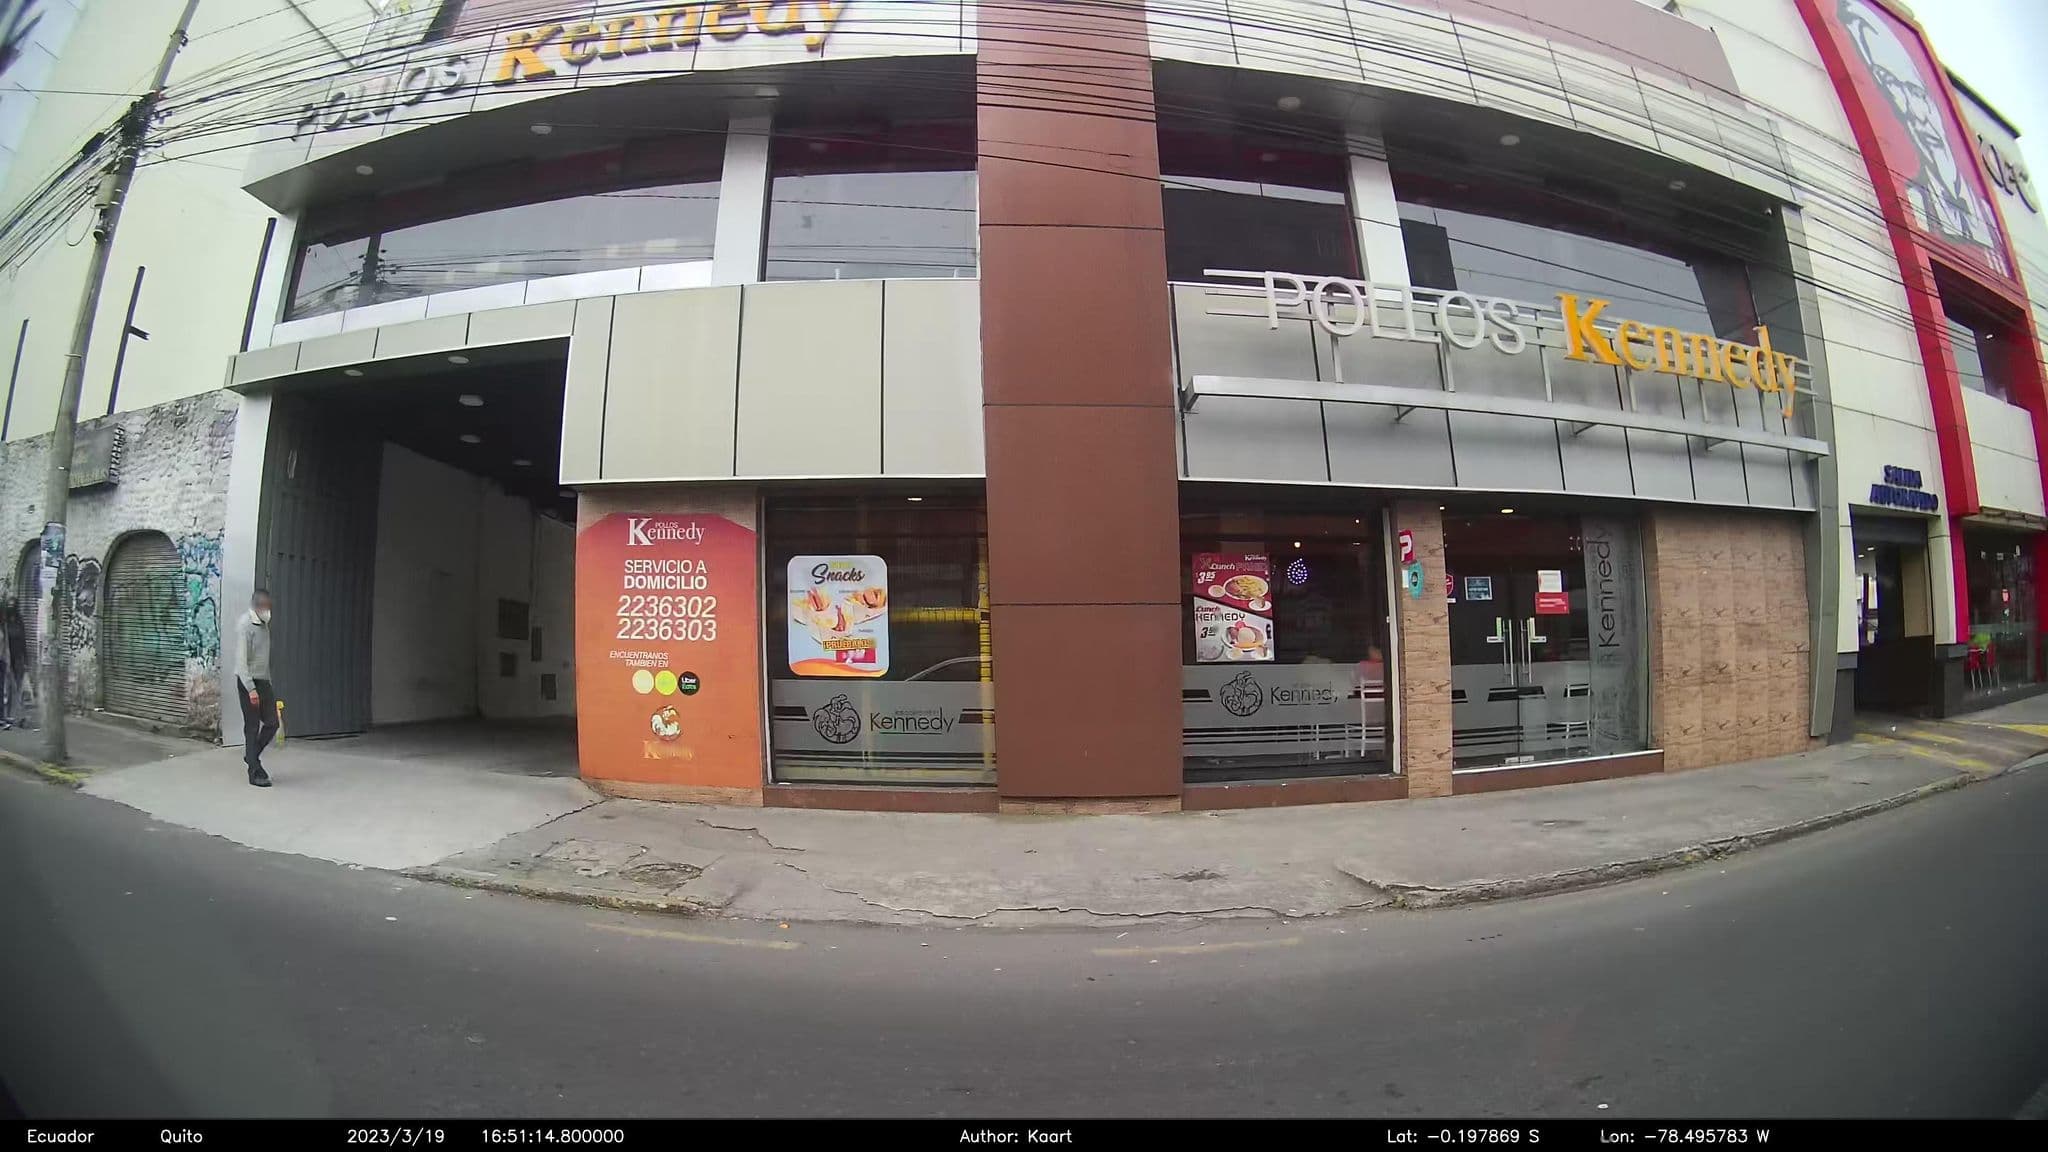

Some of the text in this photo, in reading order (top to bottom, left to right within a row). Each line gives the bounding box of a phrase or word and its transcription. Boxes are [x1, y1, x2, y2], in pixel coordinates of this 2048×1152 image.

[1264, 271, 1799, 419] POLLOS Kennedy
[626, 517, 706, 546] Kennedy
[624, 559, 708, 574] SERVICIO A
[812, 563, 865, 585] Snacks
[623, 575, 708, 590] DOMICILIO
[616, 595, 717, 618] 2236302
[616, 618, 717, 641] 2236303
[609, 650, 669, 660] ENCUENTRANOS
[658, 660, 669, 668] EN
[870, 707, 954, 733] Kennedy
